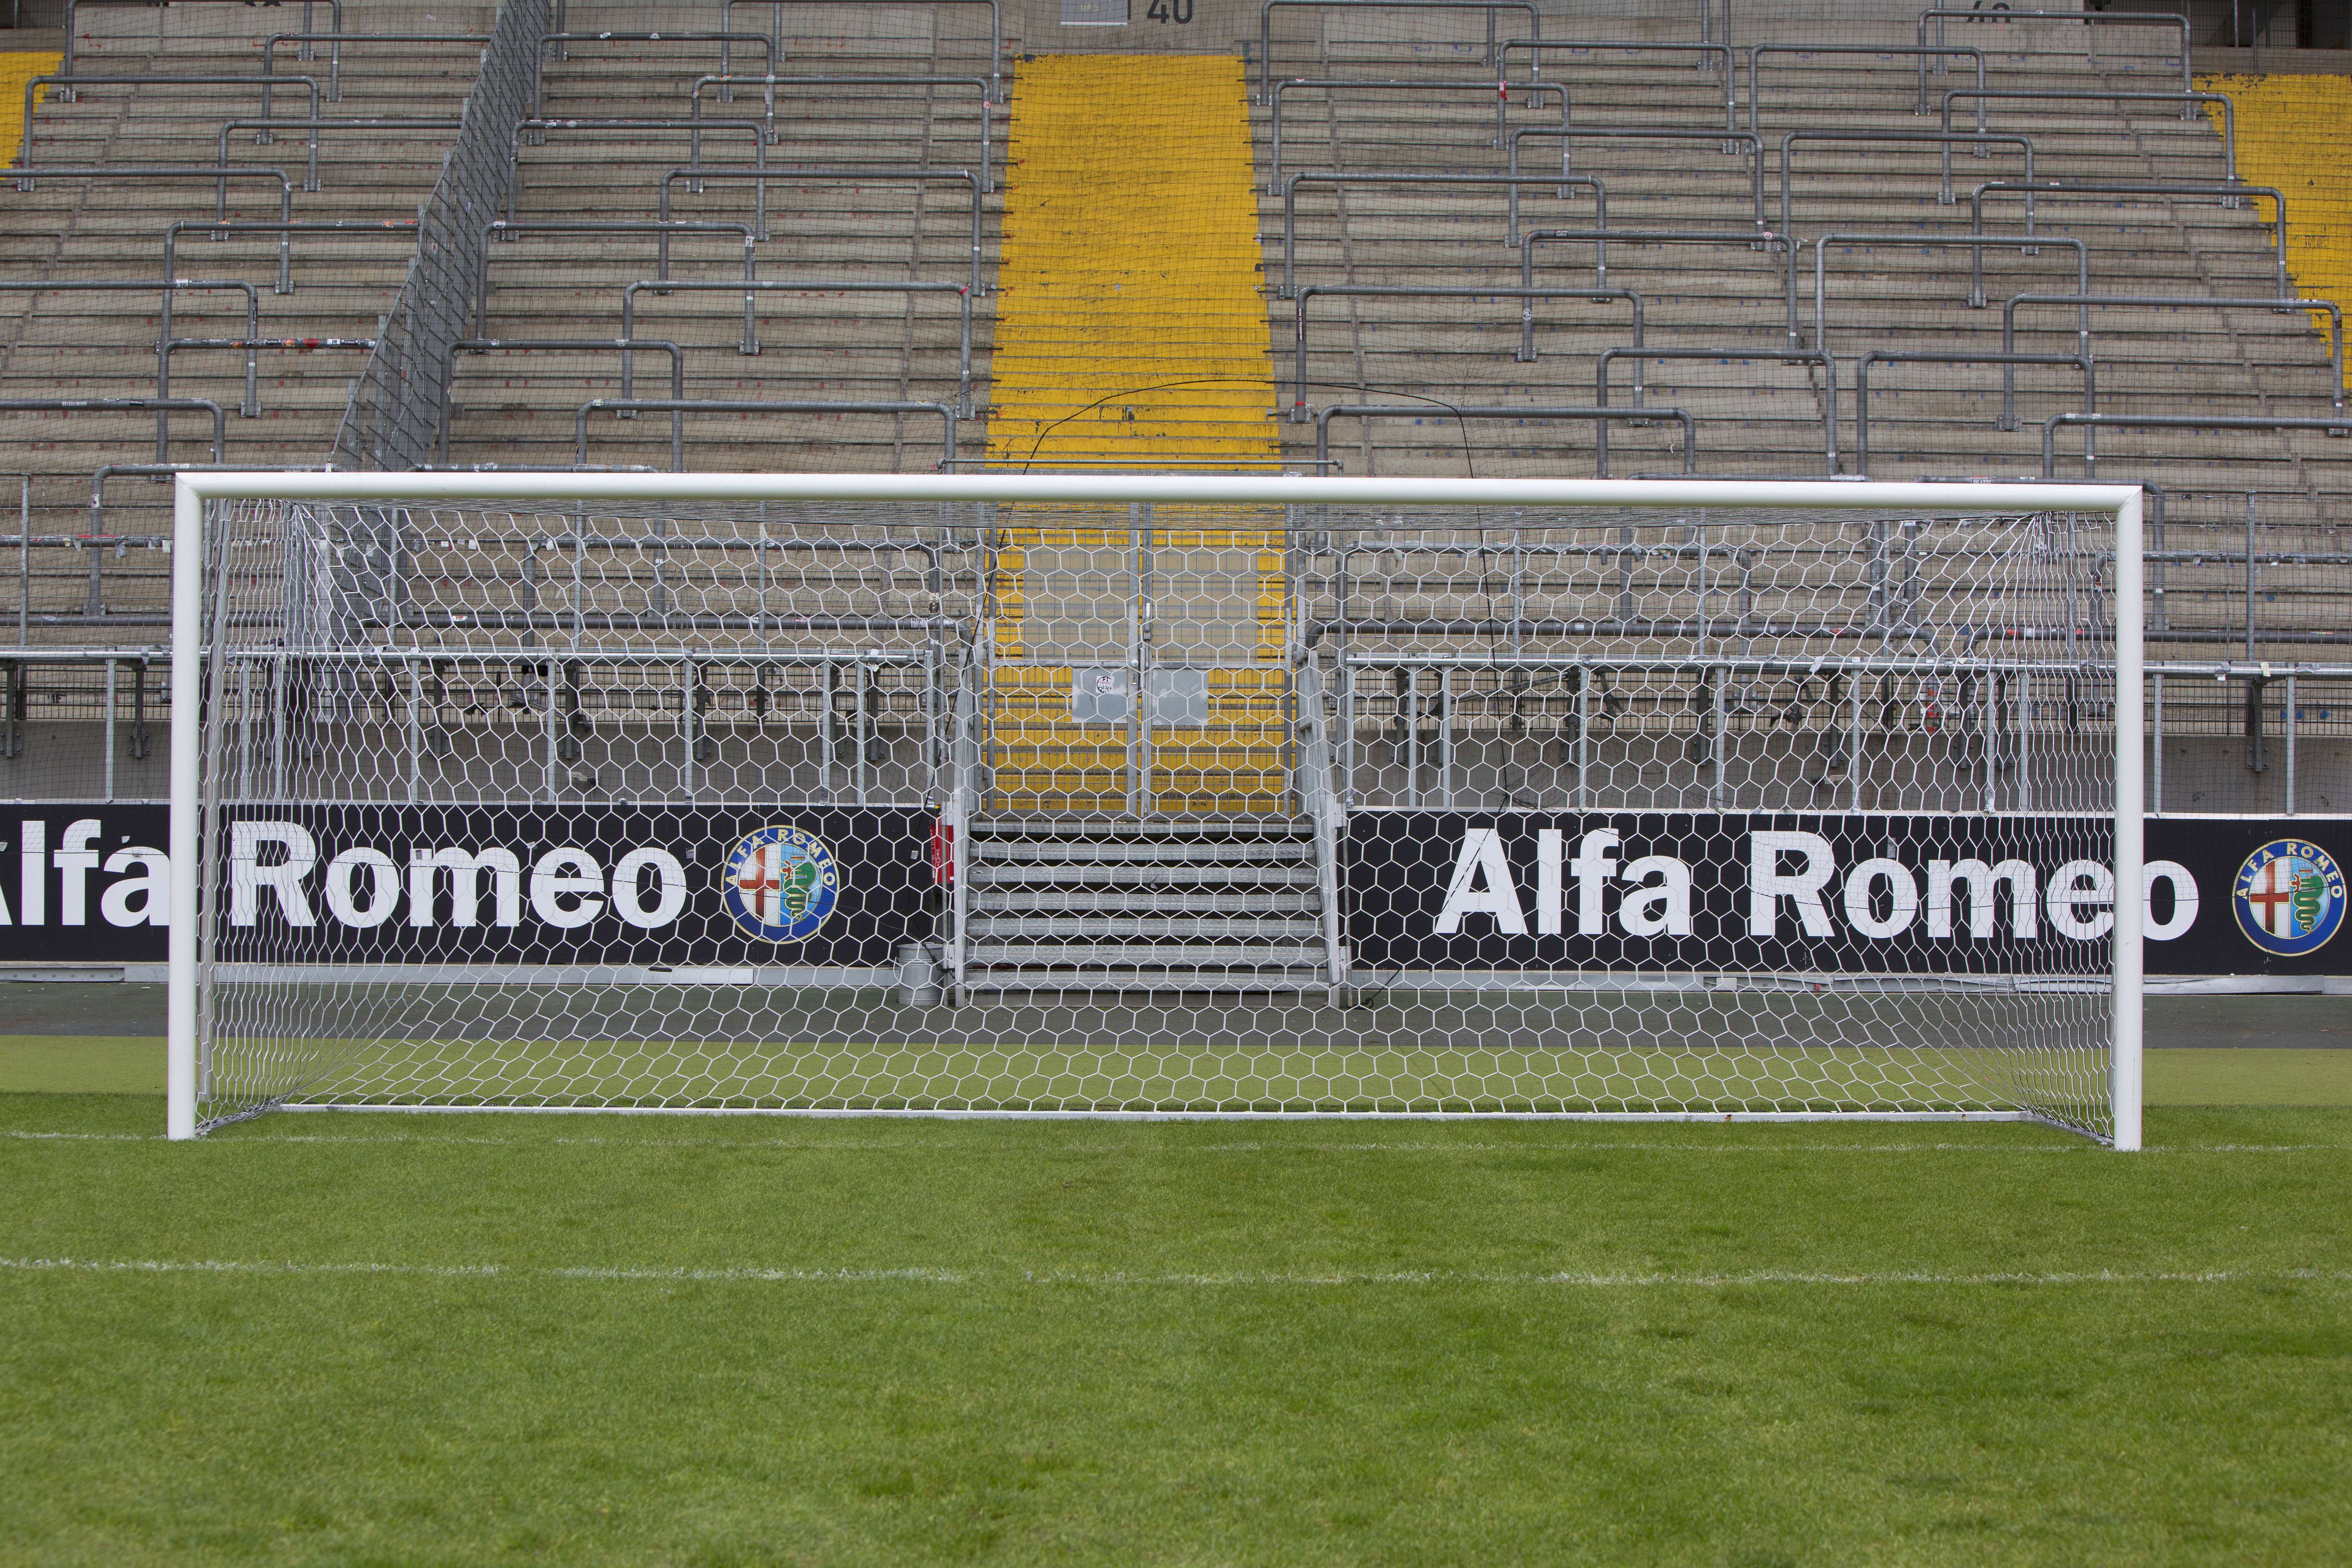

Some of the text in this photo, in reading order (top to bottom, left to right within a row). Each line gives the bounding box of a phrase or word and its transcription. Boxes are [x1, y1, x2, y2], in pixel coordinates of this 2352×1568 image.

[0, 819, 687, 928] lfa Romeo
[725, 829, 835, 886] ALFA ROMEO
[1434, 828, 2199, 941] Alfa Romeo
[2236, 842, 2343, 900] ALFA ROMEO
